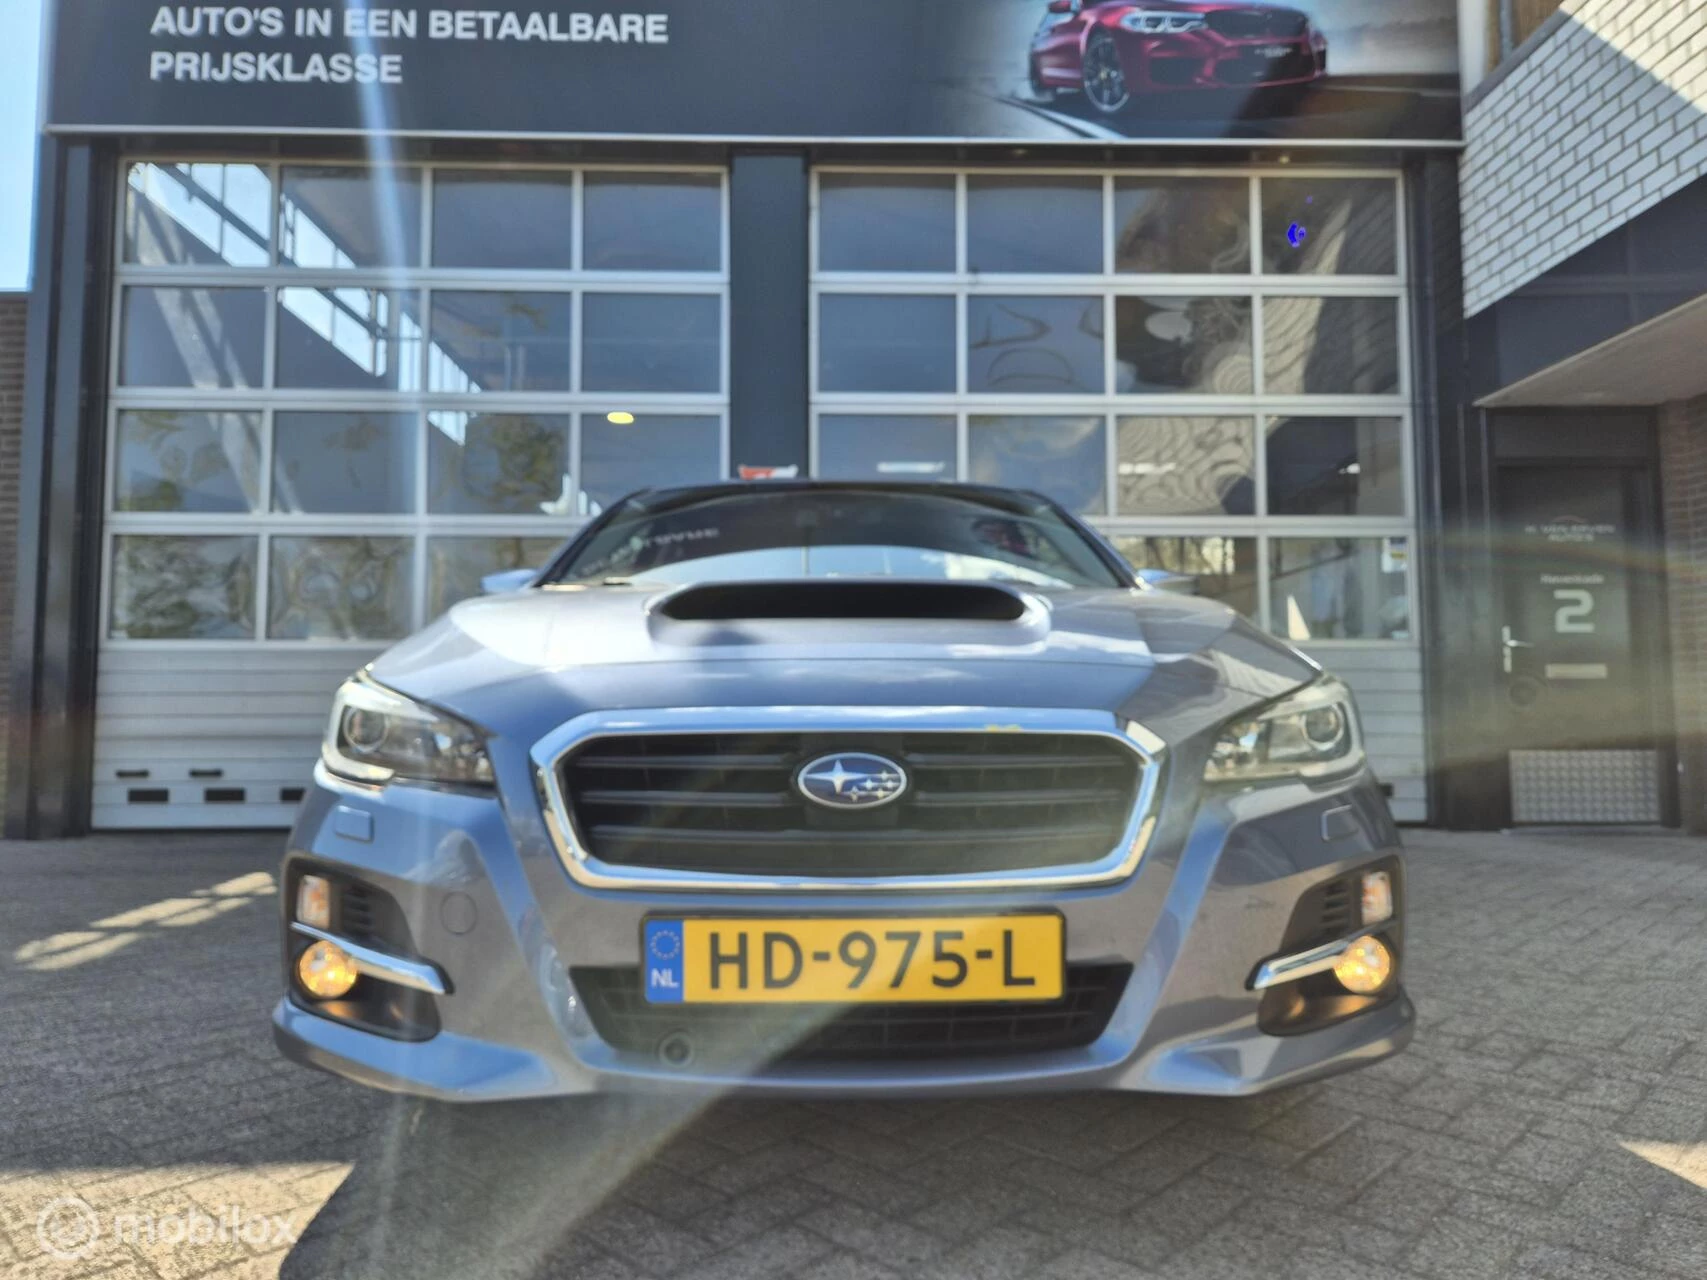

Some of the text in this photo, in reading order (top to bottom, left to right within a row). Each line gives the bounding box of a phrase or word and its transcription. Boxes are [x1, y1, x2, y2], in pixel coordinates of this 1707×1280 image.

[150, 5, 669, 44] AUTO'S IN EEN BETAALBARE
[150, 51, 403, 84] PRIJSKLASSE
[1553, 589, 1595, 633] 2
[651, 968, 679, 988] NL
[709, 929, 1036, 990] HD-975-L
